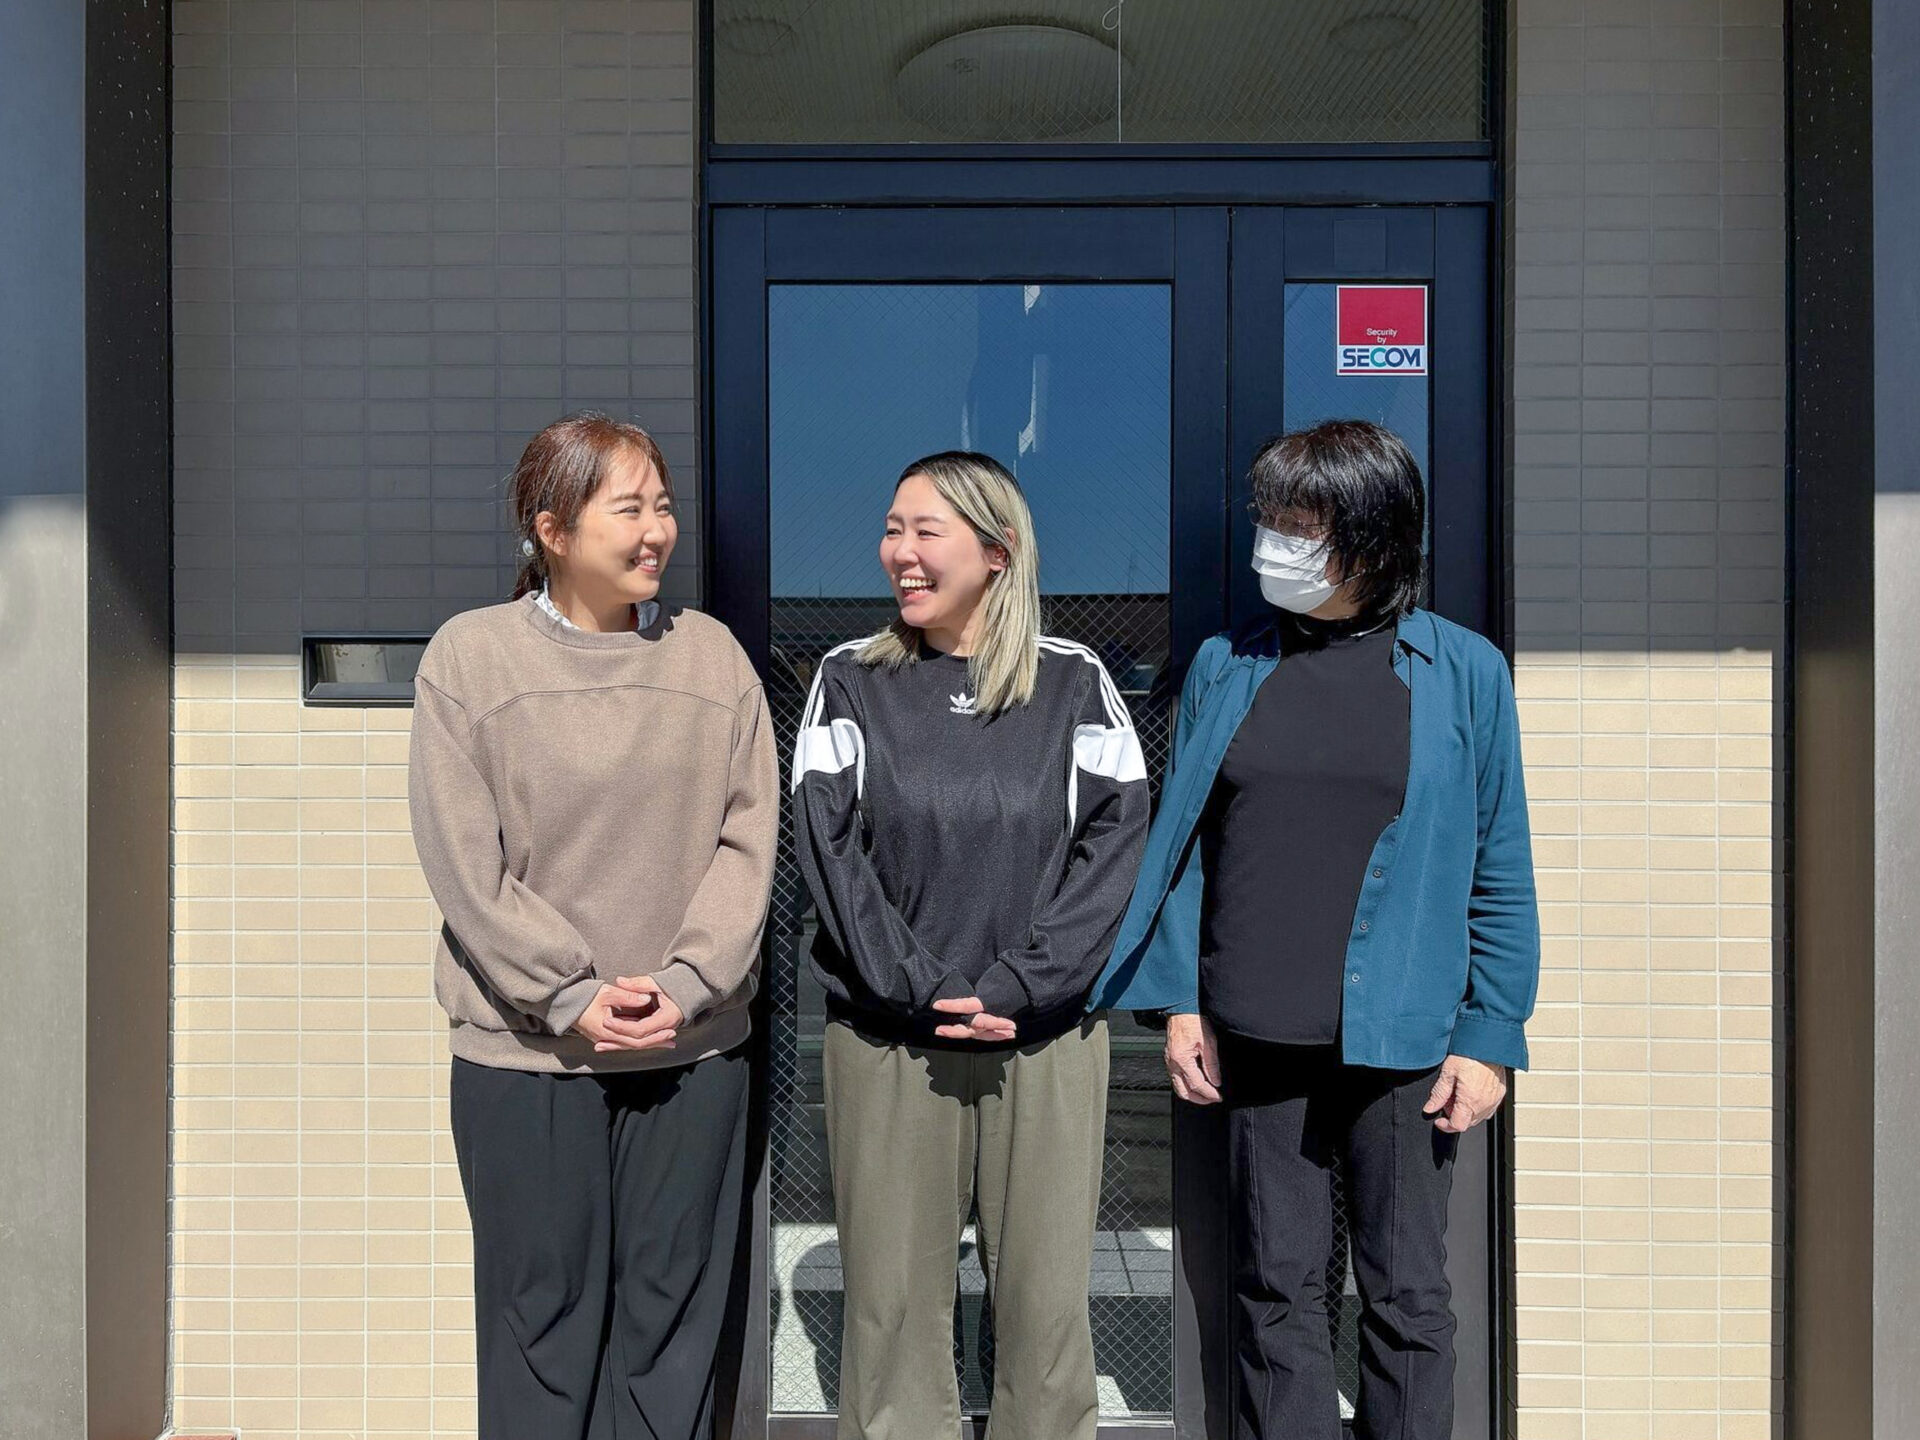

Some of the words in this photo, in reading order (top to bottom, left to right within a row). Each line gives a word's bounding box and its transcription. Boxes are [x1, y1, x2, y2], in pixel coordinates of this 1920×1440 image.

[1366, 328, 1398, 337] Security
[1377, 336, 1387, 344] by
[1343, 347, 1420, 367] SECOM
